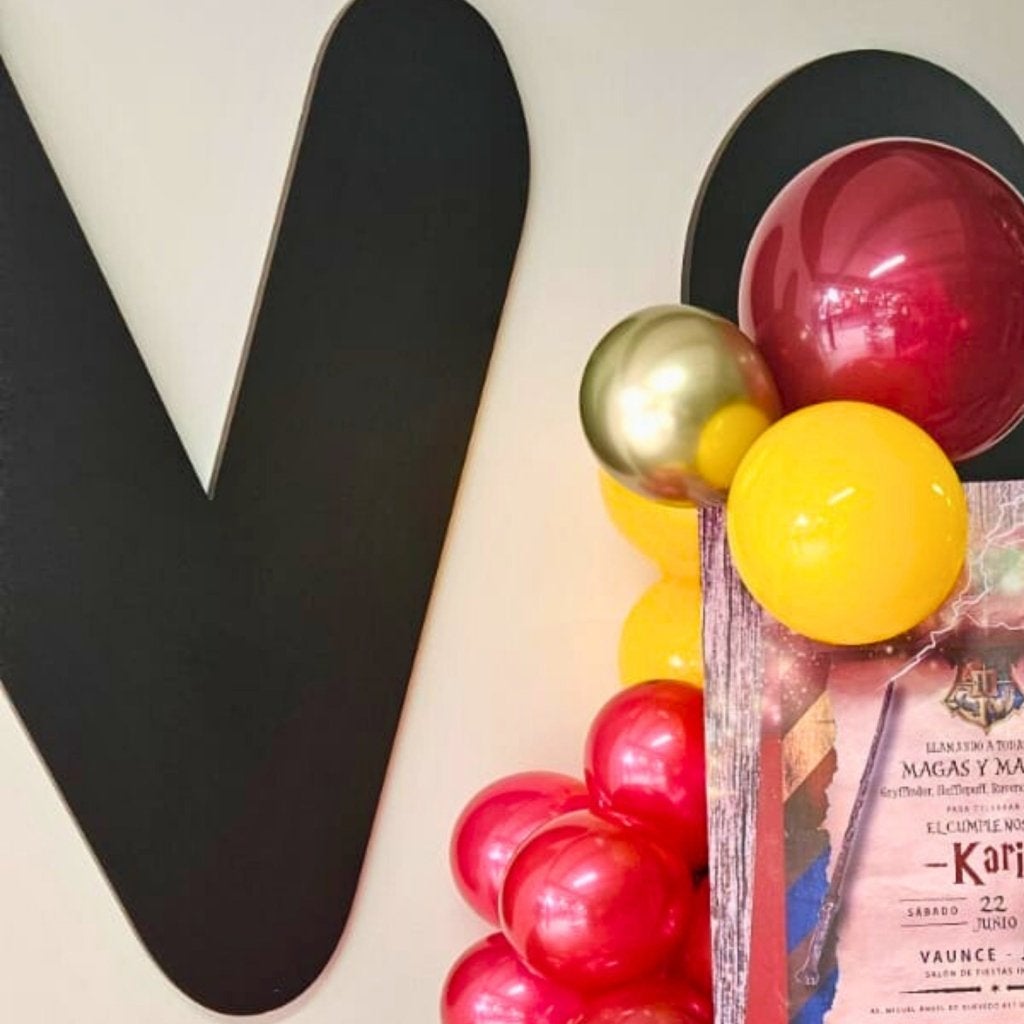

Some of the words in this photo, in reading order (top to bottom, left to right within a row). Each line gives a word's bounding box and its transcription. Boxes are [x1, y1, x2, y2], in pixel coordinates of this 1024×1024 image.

[901, 759, 970, 779] MAGAS
[976, 758, 988, 777] Y
[953, 841, 1024, 886] Kari
[980, 895, 1008, 912] 22
[973, 916, 1018, 932] JUNIO
[919, 948, 996, 964] VAUNCE
[960, 969, 971, 977] DE
[976, 967, 1013, 976] FIESTAS
